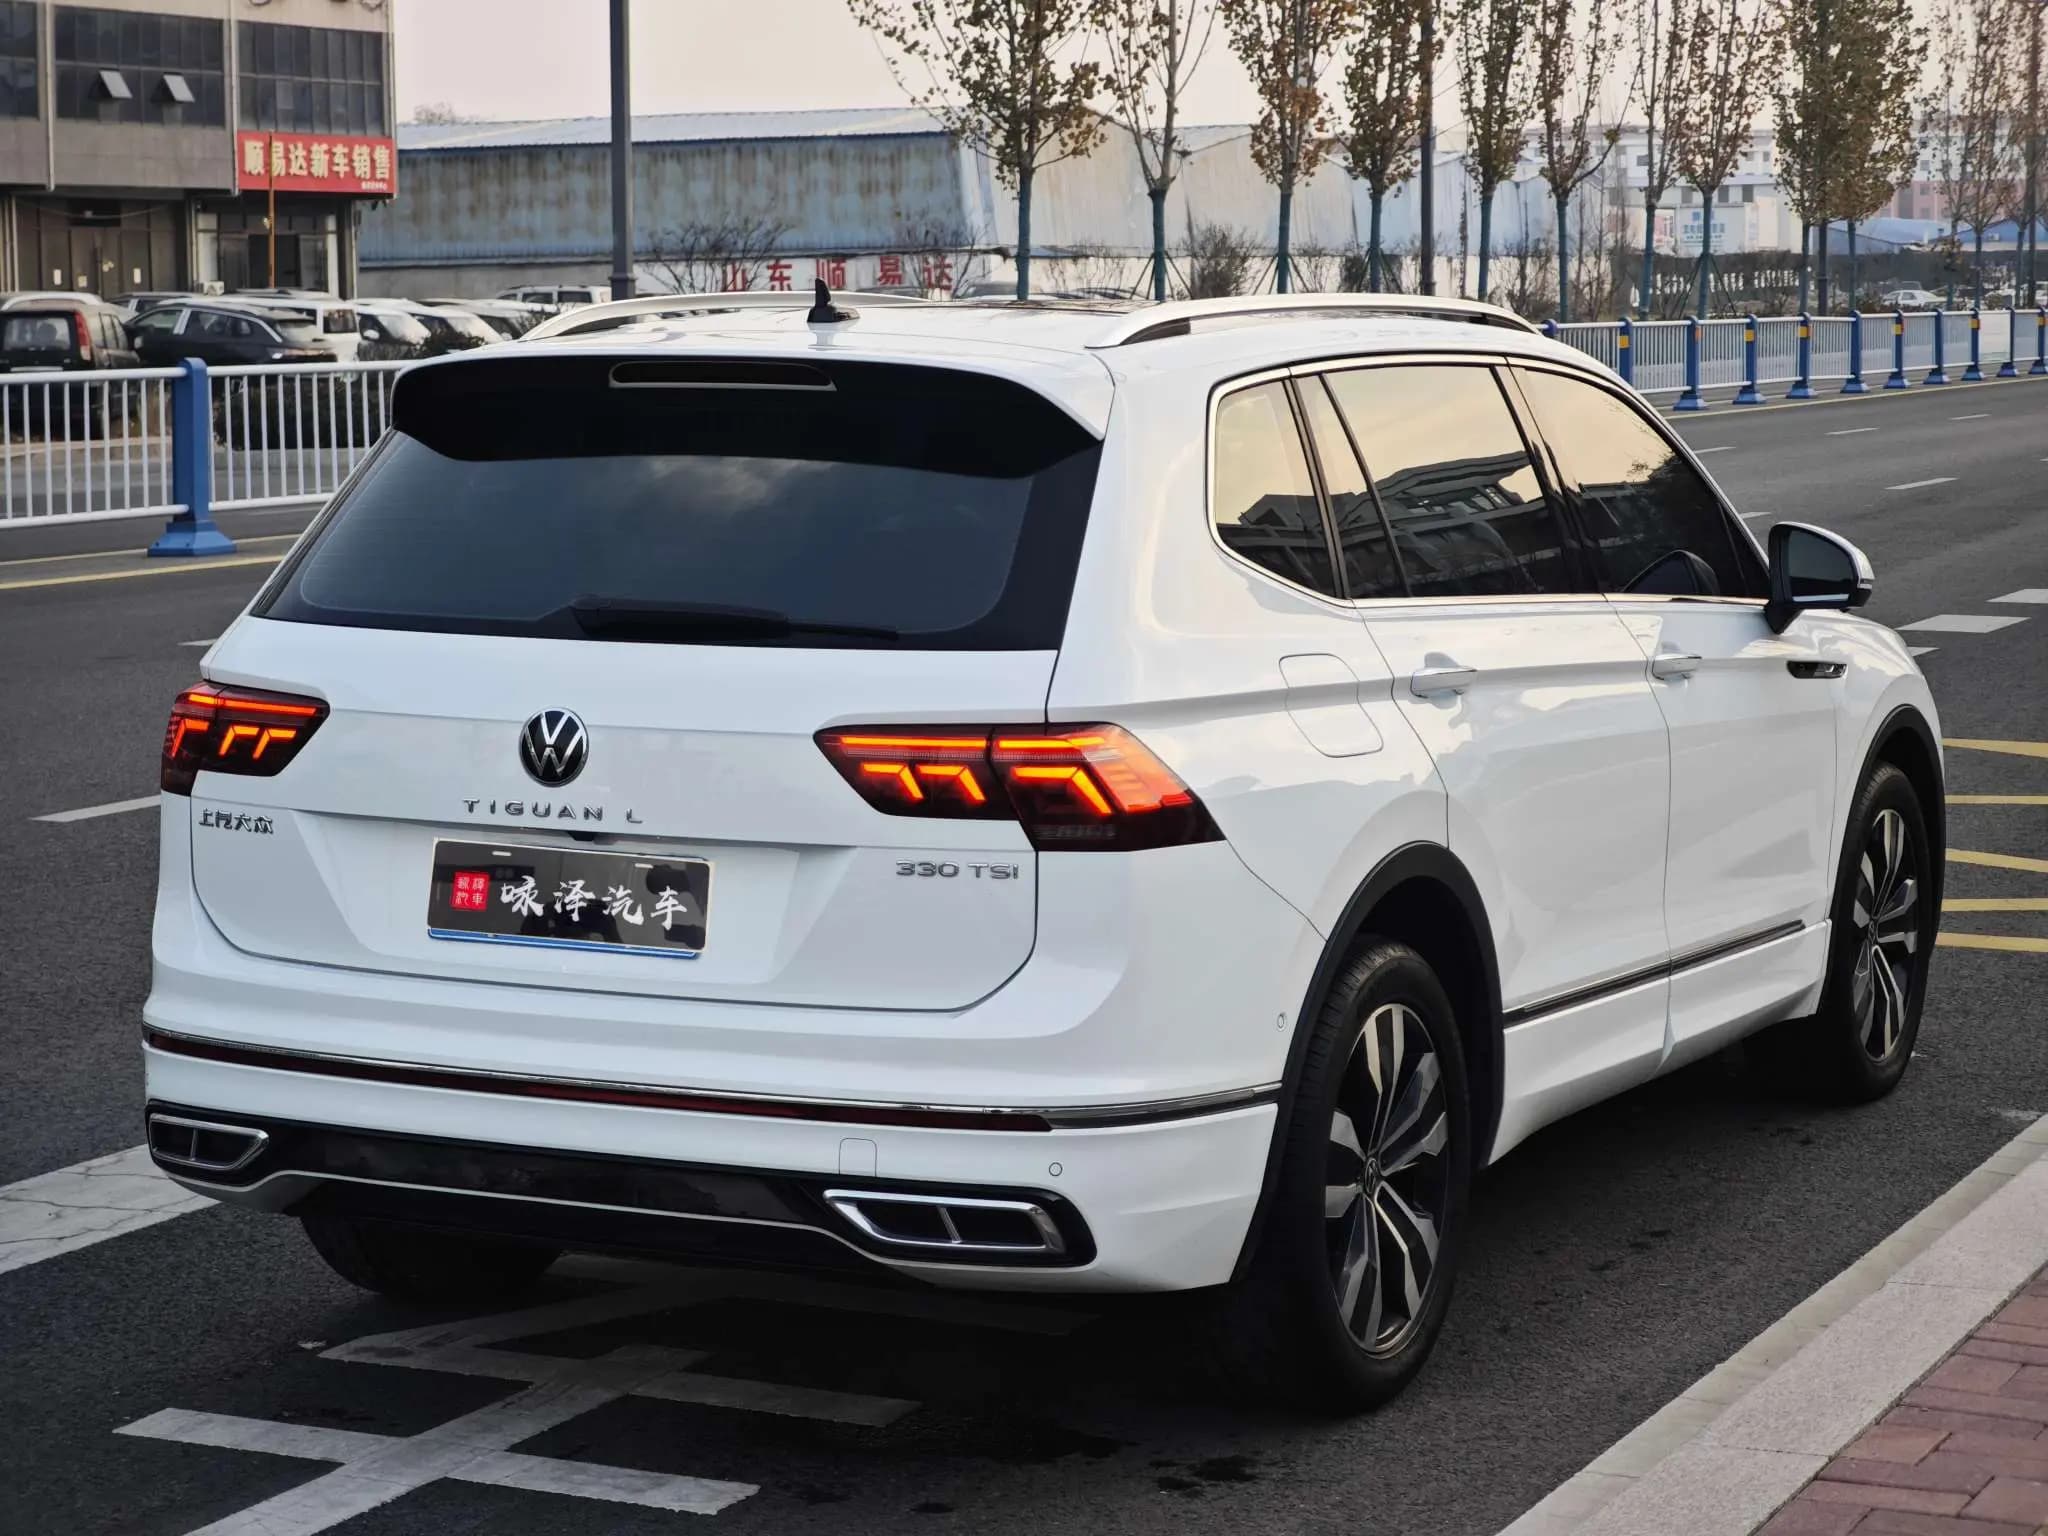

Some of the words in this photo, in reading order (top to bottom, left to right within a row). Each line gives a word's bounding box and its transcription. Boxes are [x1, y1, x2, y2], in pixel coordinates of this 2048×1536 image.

[244, 140, 390, 180] 顺易达新车销售
[722, 254, 954, 292] 山东顺易达
[198, 807, 274, 835] 上汽大众
[463, 798, 604, 821] TIGUAN
[625, 807, 643, 824] L
[896, 860, 961, 879] 330
[967, 862, 1020, 880] TSI
